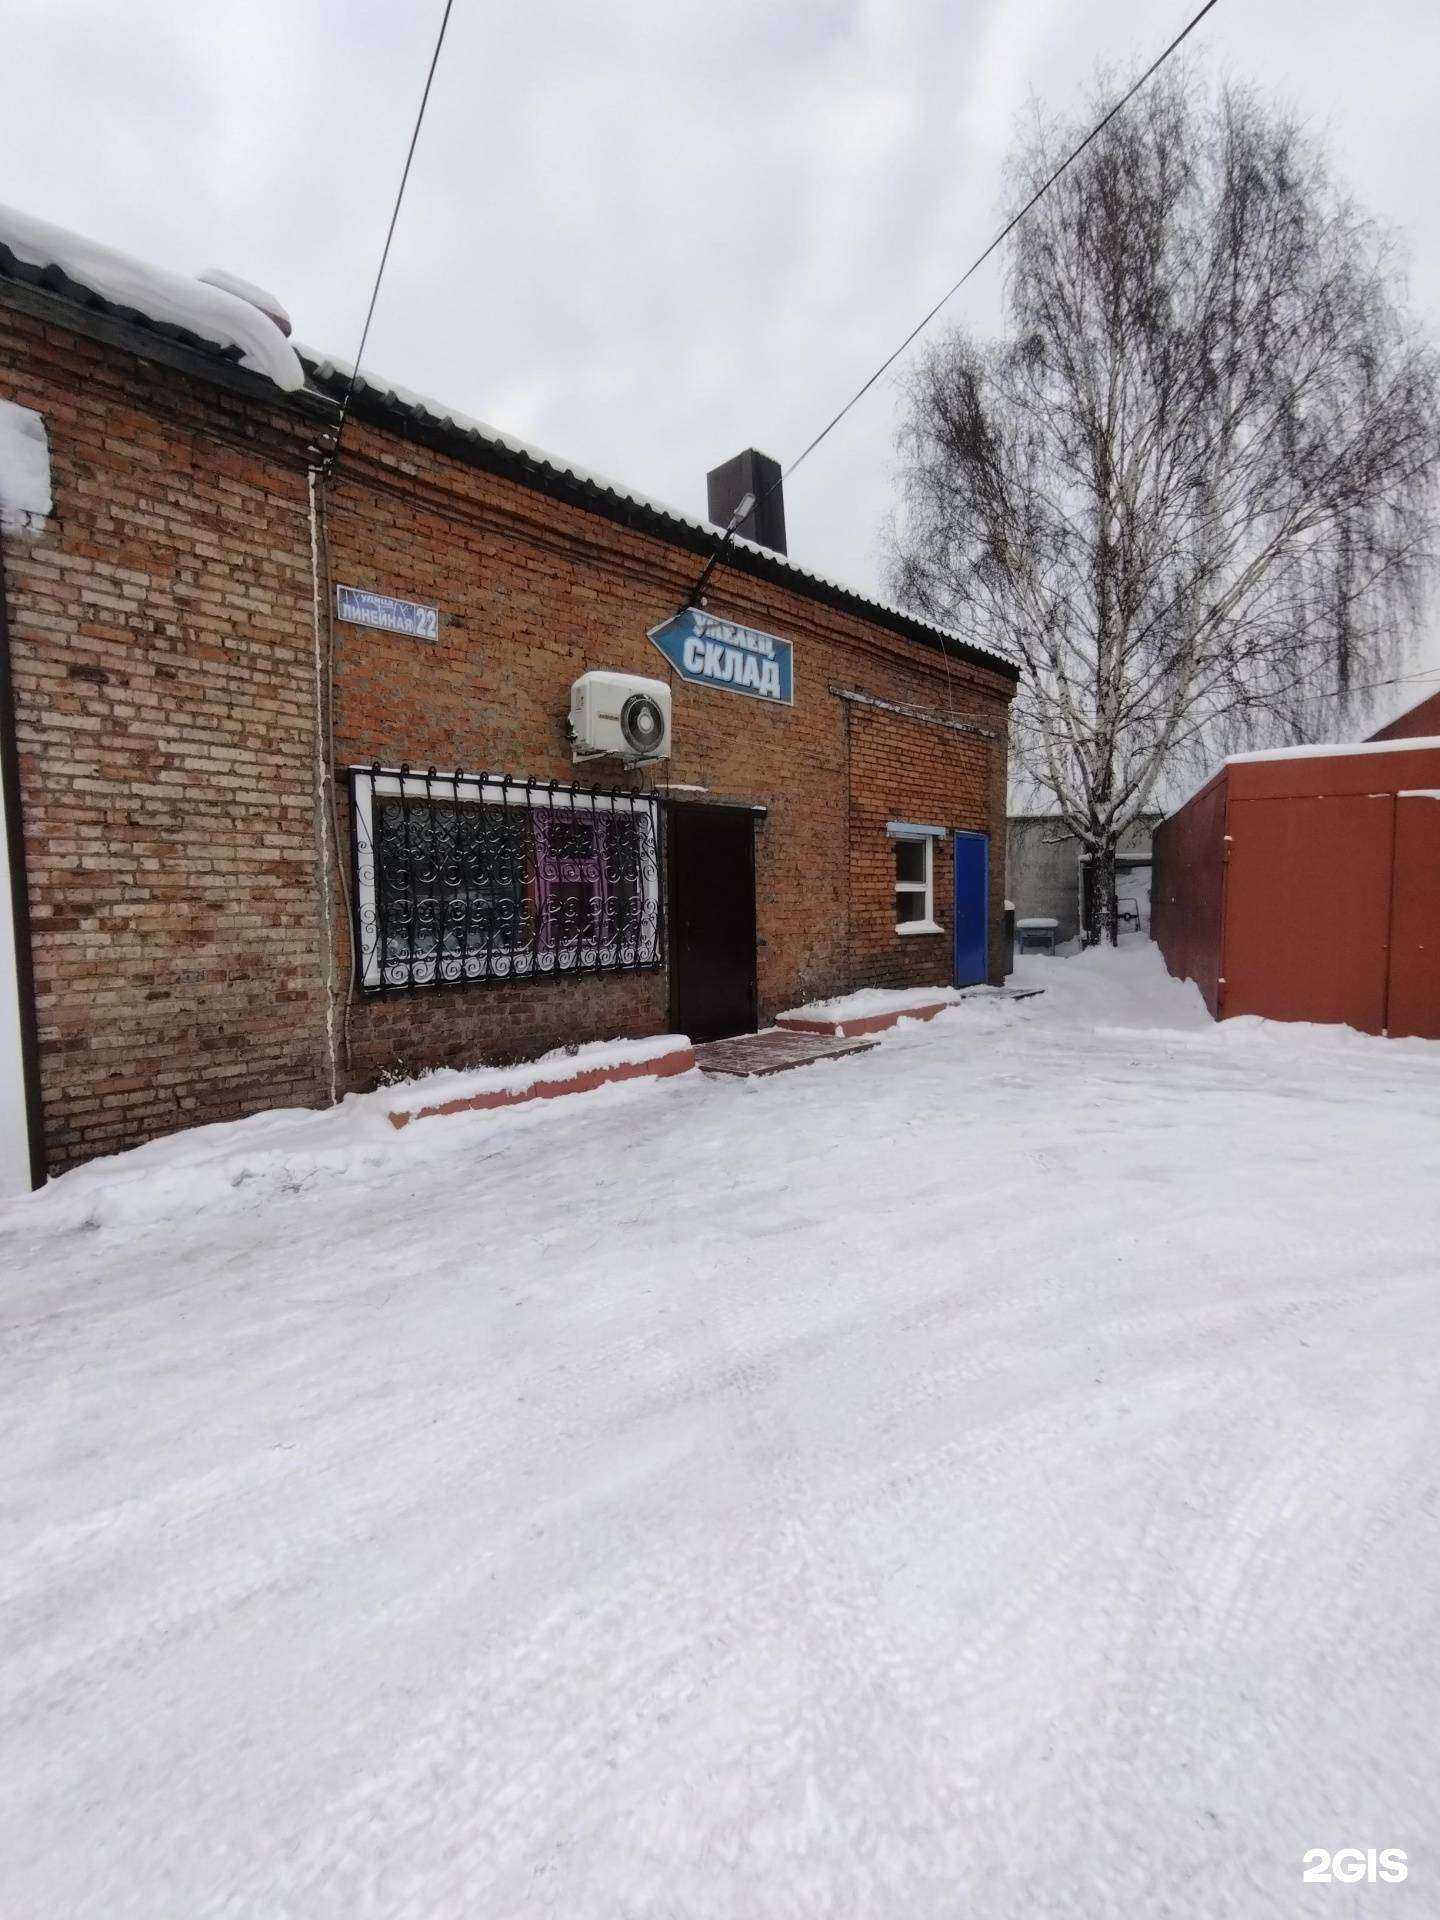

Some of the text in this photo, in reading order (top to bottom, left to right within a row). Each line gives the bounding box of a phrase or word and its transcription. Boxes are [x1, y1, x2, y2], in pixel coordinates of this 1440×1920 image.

[342, 603, 414, 632] ЛИНЕЙНАЯ
[416, 607, 437, 637] 22
[683, 637, 781, 700] СКЛАД
